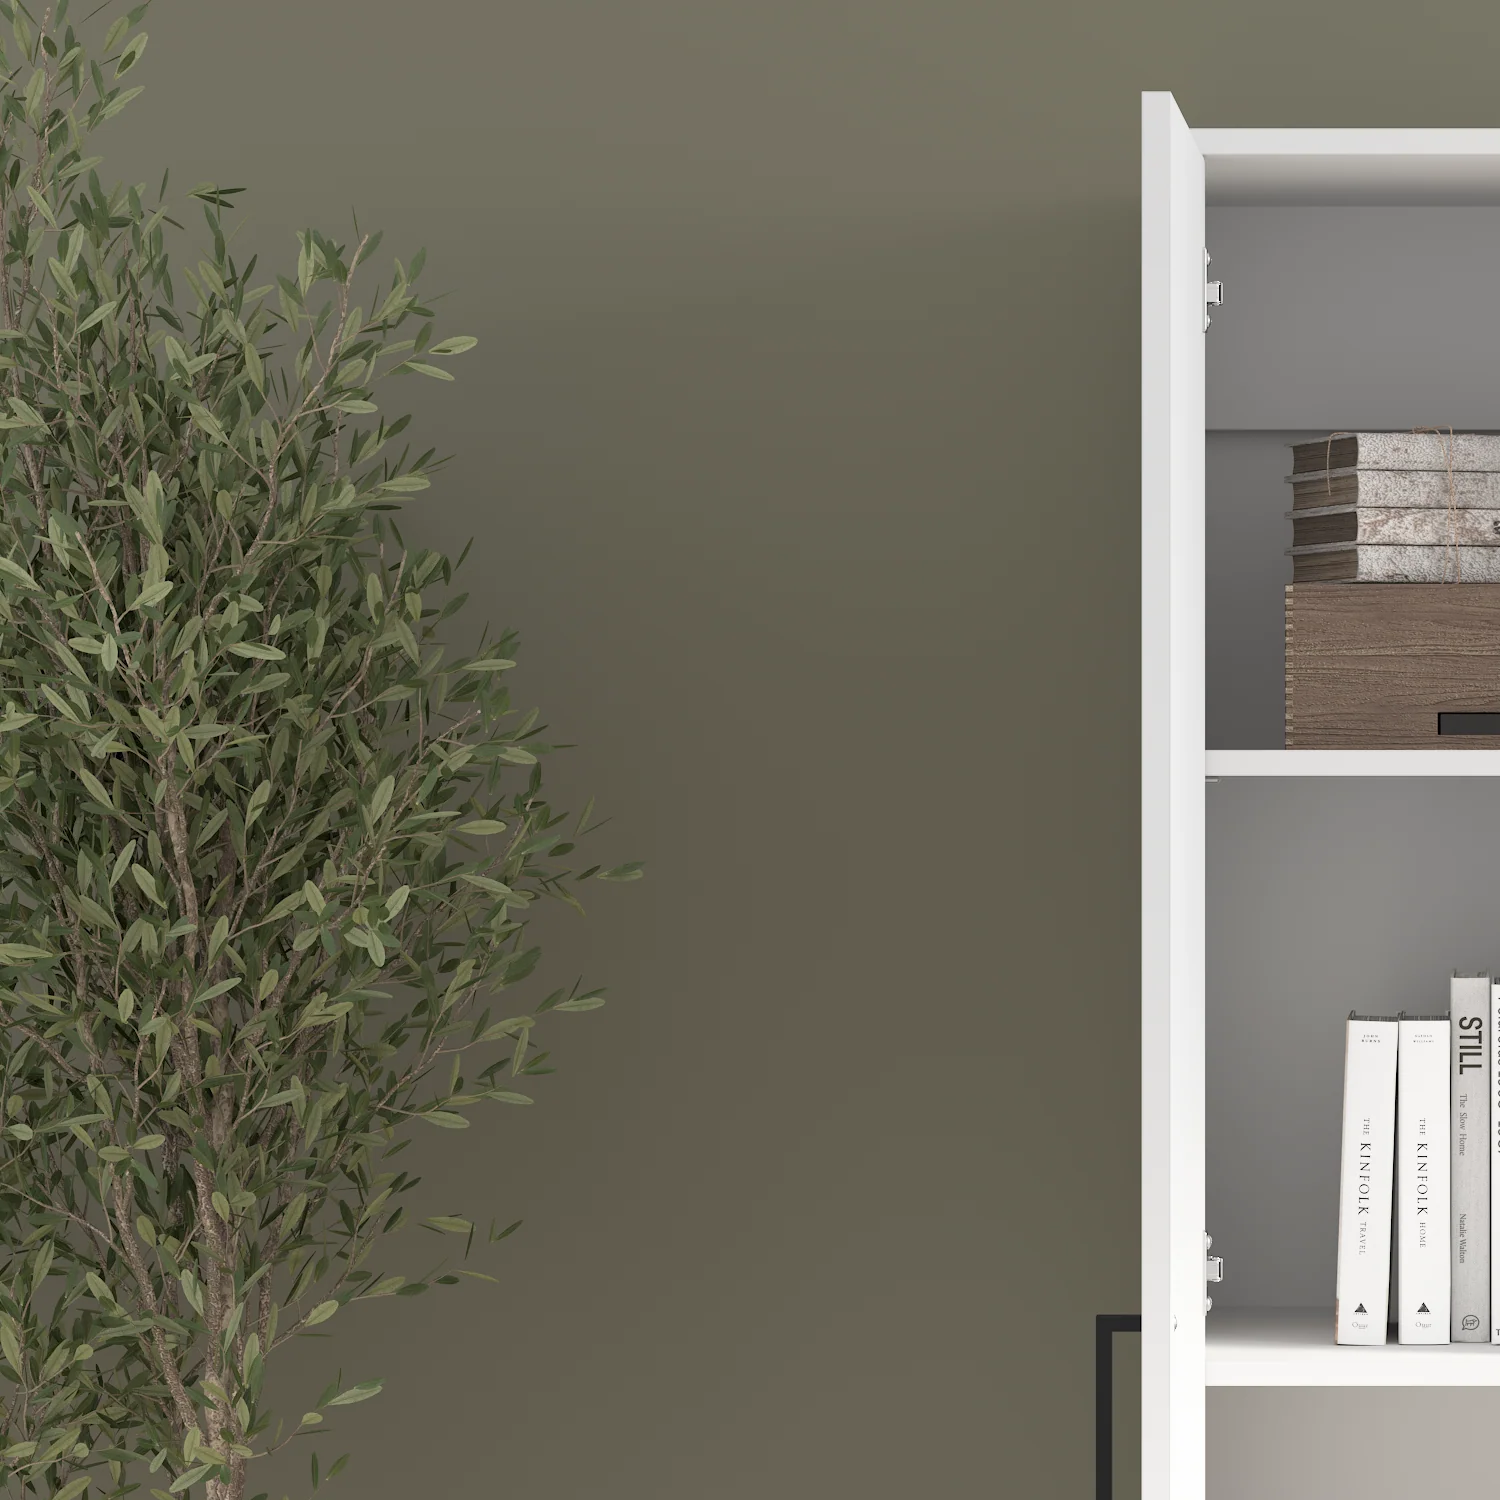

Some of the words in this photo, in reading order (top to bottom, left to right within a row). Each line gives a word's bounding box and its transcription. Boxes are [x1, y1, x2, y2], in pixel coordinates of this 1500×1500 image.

[1458, 1016, 1483, 1075] STILL
[1459, 1093, 1467, 1108] The
[1459, 1112, 1467, 1130] Slow
[1459, 1133, 1467, 1156] Home
[1358, 1143, 1371, 1216] KINFOLK
[1417, 1143, 1428, 1216] KINFOLK
[1459, 1213, 1467, 1237] Natalie
[1359, 1221, 1367, 1256] TRAVEL
[1459, 1238, 1467, 1264] Walton
